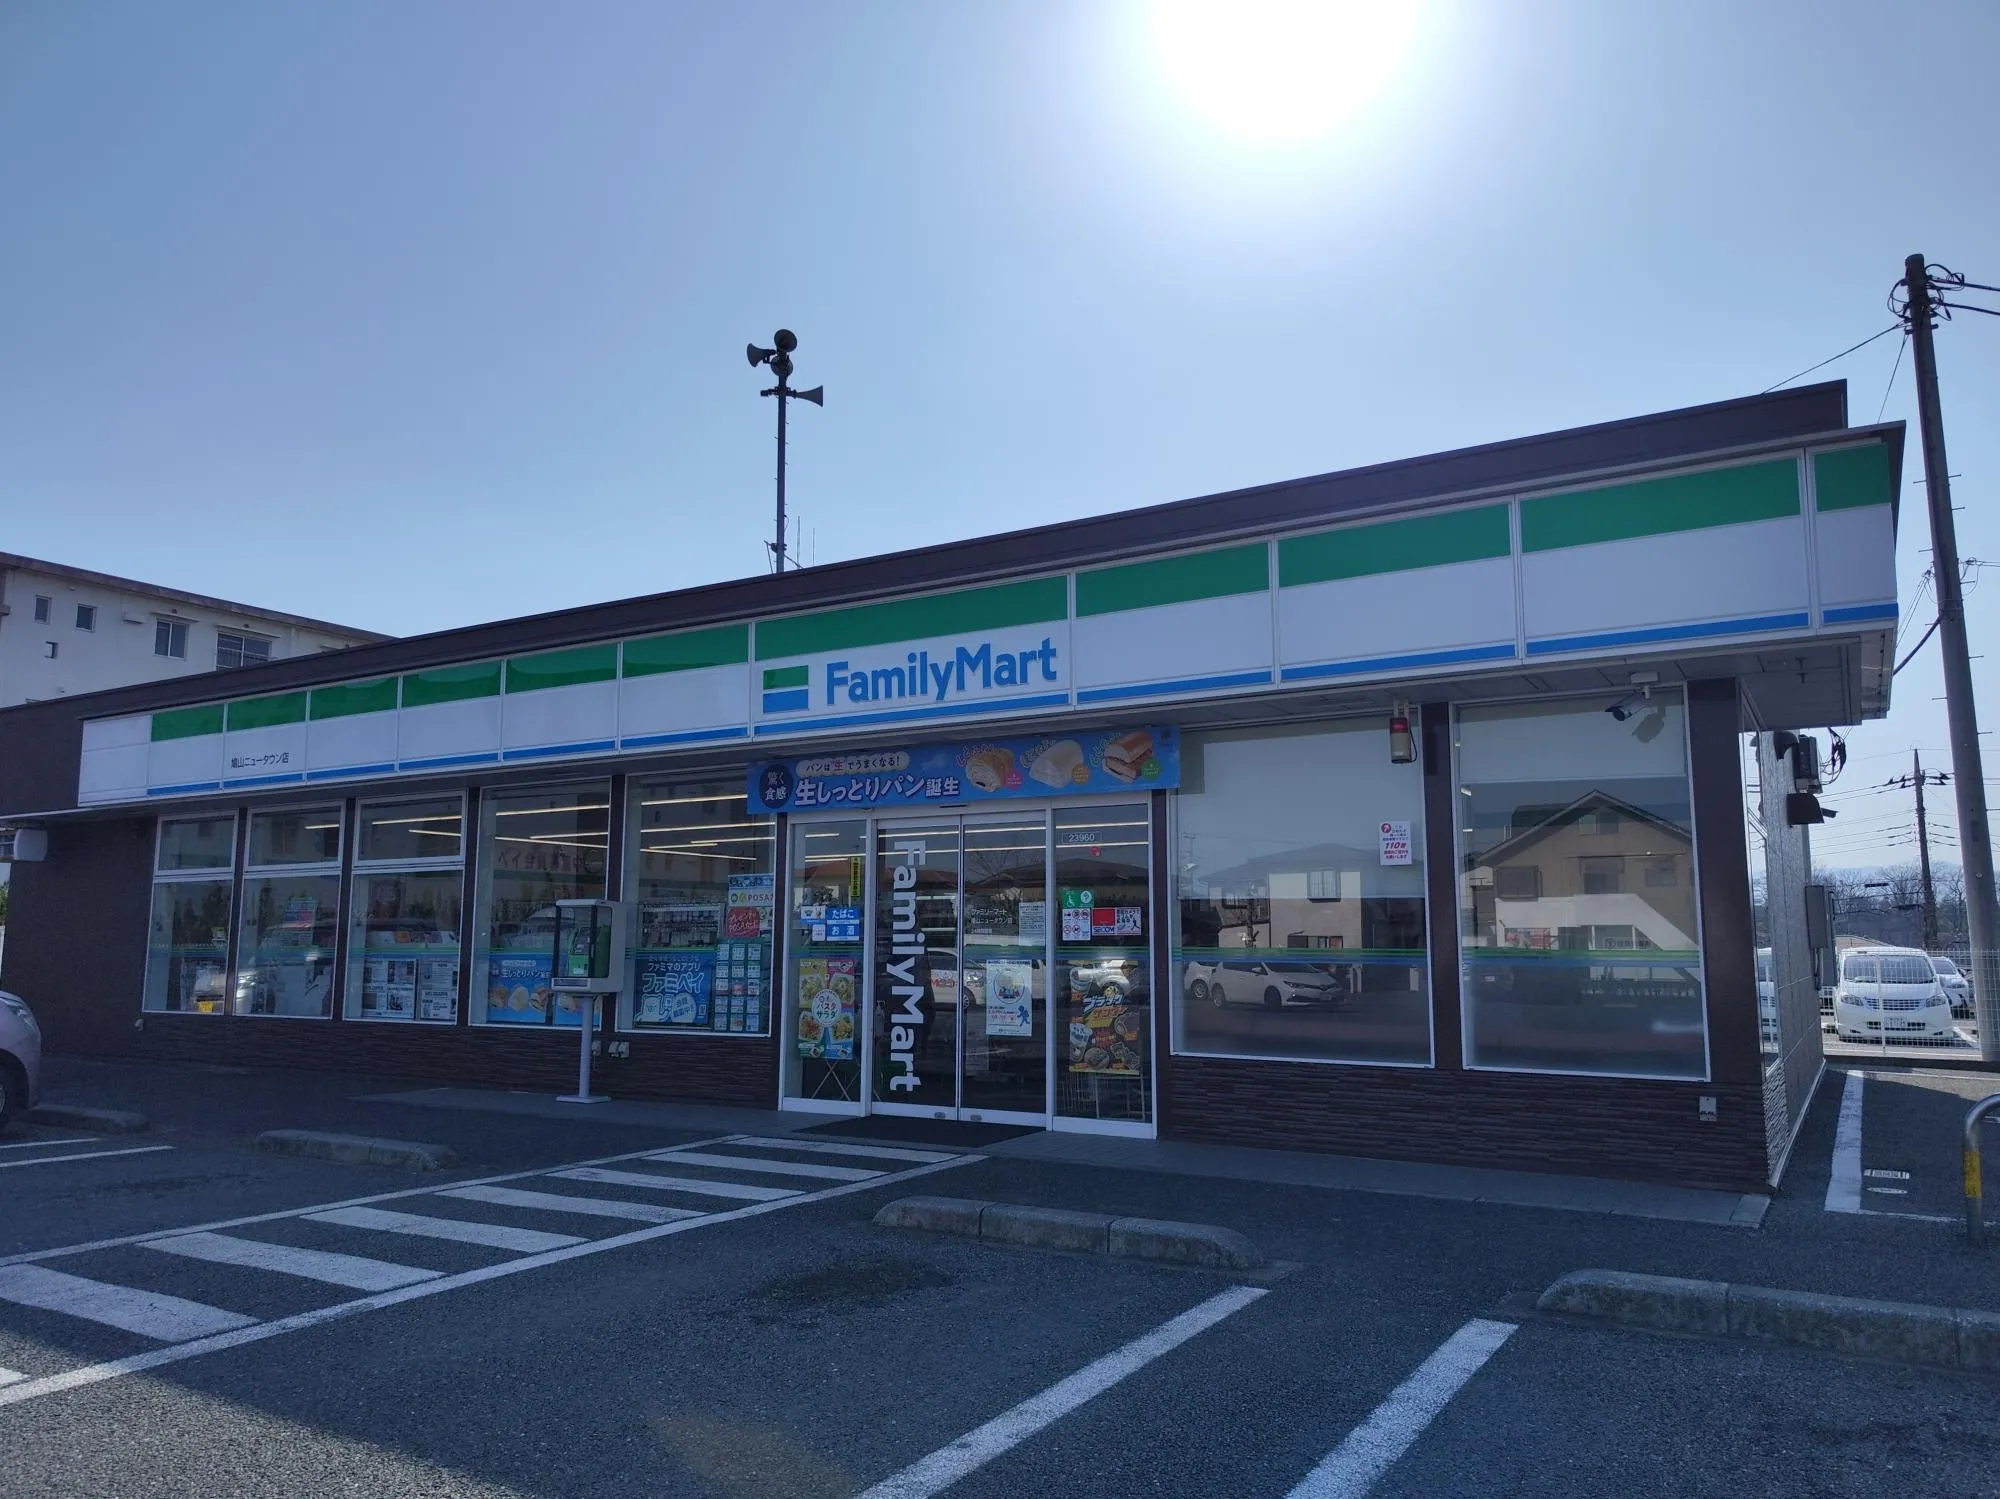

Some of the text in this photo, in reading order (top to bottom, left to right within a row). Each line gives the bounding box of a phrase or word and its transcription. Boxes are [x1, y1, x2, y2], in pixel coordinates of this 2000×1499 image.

[827, 637, 1057, 705] FamilyMart
[767, 771, 785, 786] 驚く
[764, 787, 787, 801] 食感
[794, 773, 960, 806] 生しっとりパン誕生
[1068, 833, 1095, 842] 23960
[831, 909, 856, 919] たばこ
[647, 961, 700, 972] ファミマのアプリ
[887, 840, 926, 1092] FamilyMart
[641, 972, 705, 993] ファミペイ
[816, 1009, 838, 1019] サラダ
